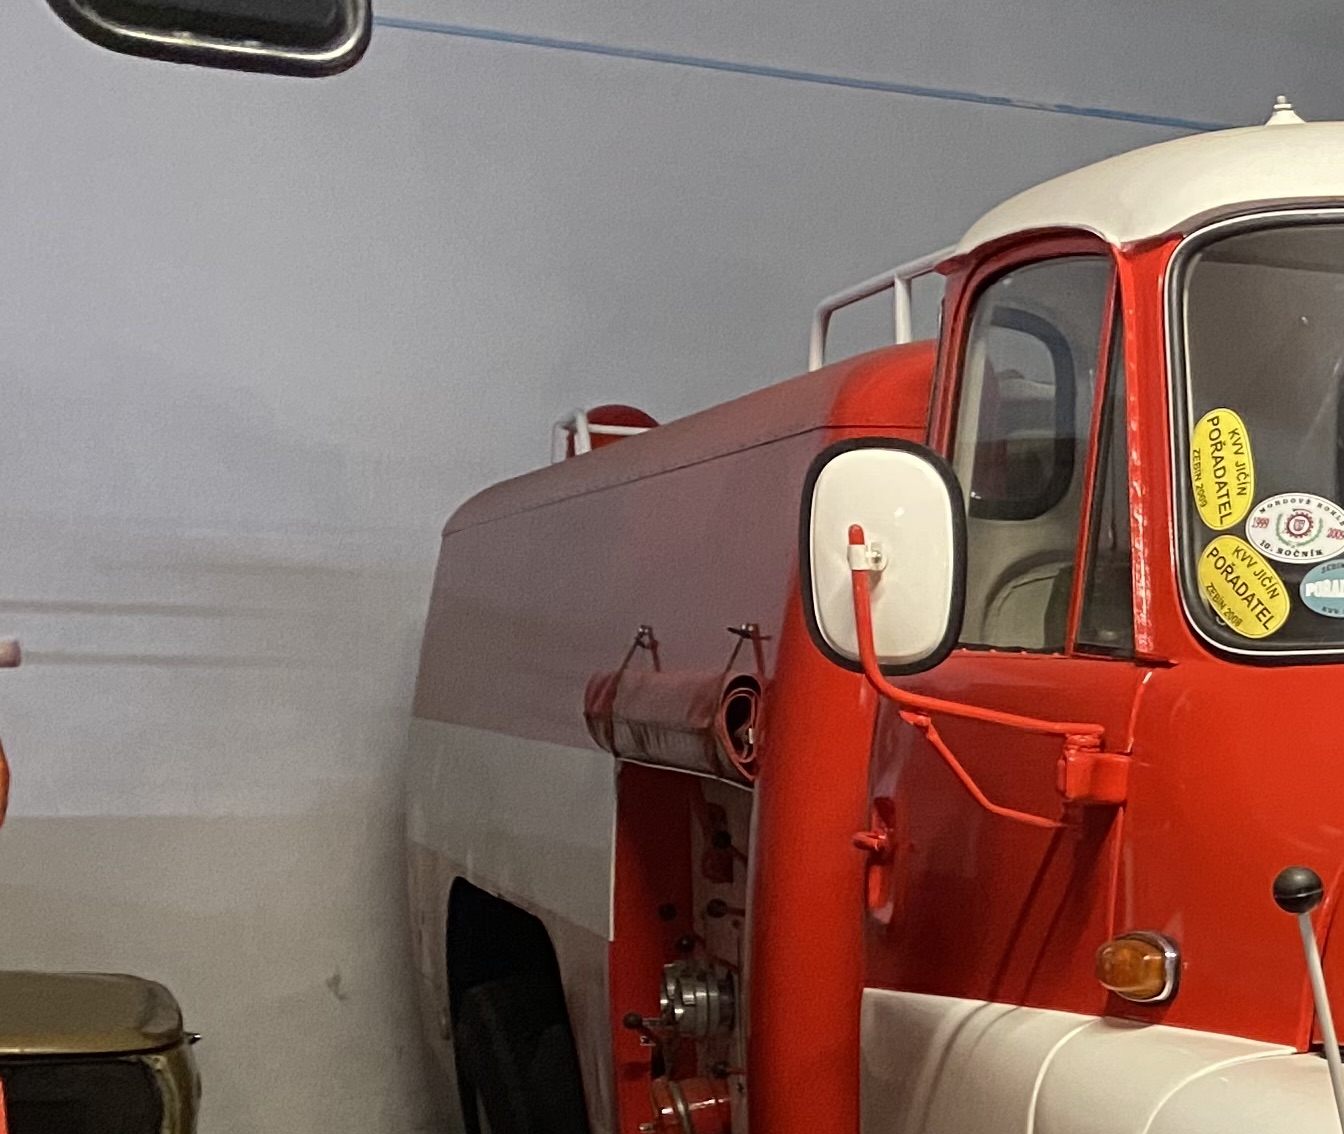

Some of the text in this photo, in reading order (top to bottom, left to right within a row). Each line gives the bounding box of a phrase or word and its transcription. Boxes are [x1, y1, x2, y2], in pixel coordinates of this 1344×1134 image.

[1207, 415, 1232, 525] POŘADATEL
[1228, 428, 1251, 496] KVV JIČÍN
[1206, 546, 1274, 630] POŘADATEL
[1232, 545, 1280, 599] KVV JIČÍN
